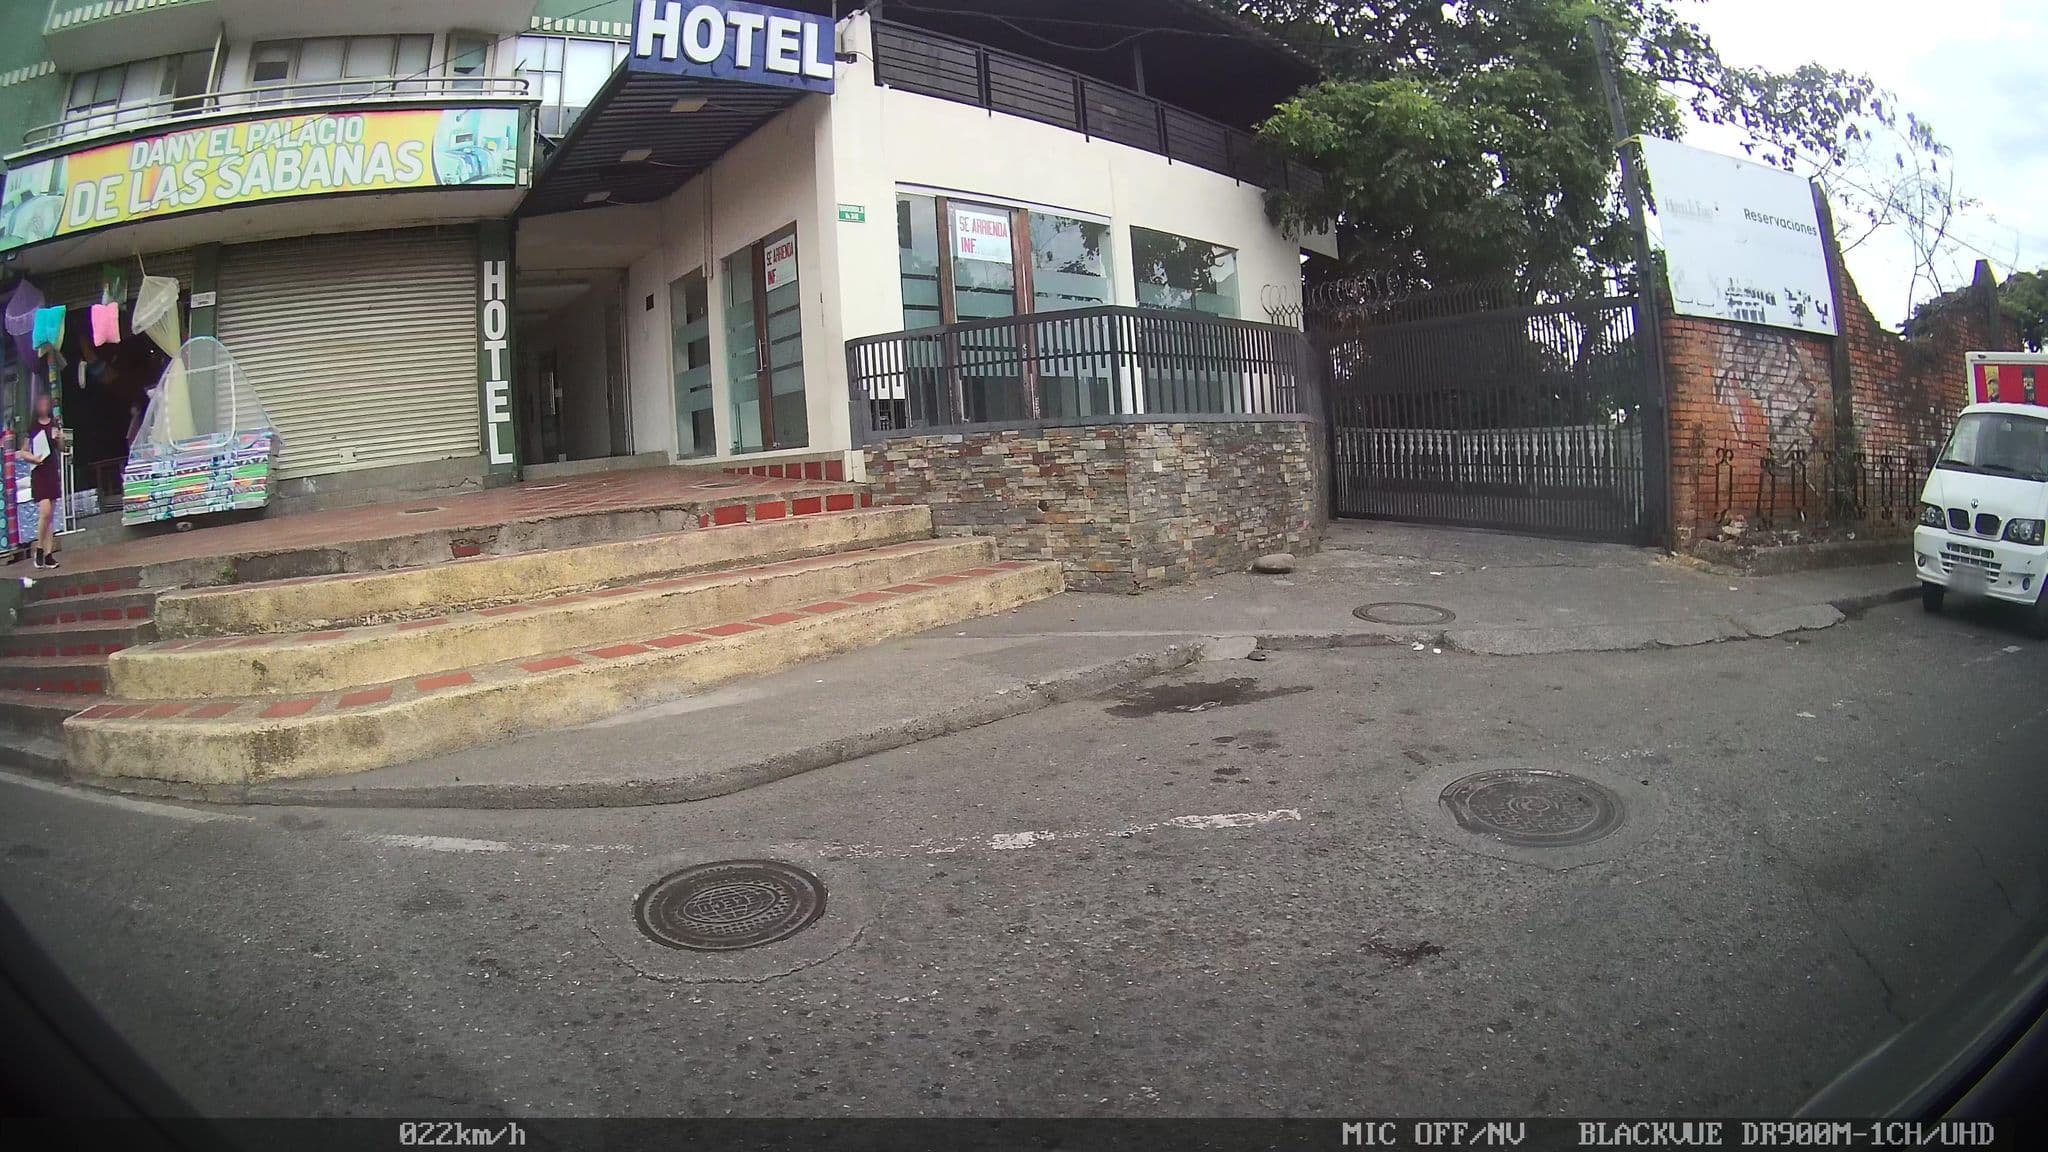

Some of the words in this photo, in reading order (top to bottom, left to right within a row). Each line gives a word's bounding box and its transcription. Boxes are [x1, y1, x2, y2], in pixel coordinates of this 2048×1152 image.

[636, 0, 833, 80] HOTEL
[129, 131, 206, 171] DANY
[207, 127, 241, 159] EL
[247, 115, 364, 153] PALACIO
[68, 174, 124, 227] DE
[128, 160, 208, 214] LAS
[213, 140, 425, 200] SABANAS
[959, 215, 970, 233] SE
[972, 218, 1008, 238] ARRIENDA
[1743, 207, 1817, 236] Reservaciones
[483, 260, 514, 465] HOTEL
